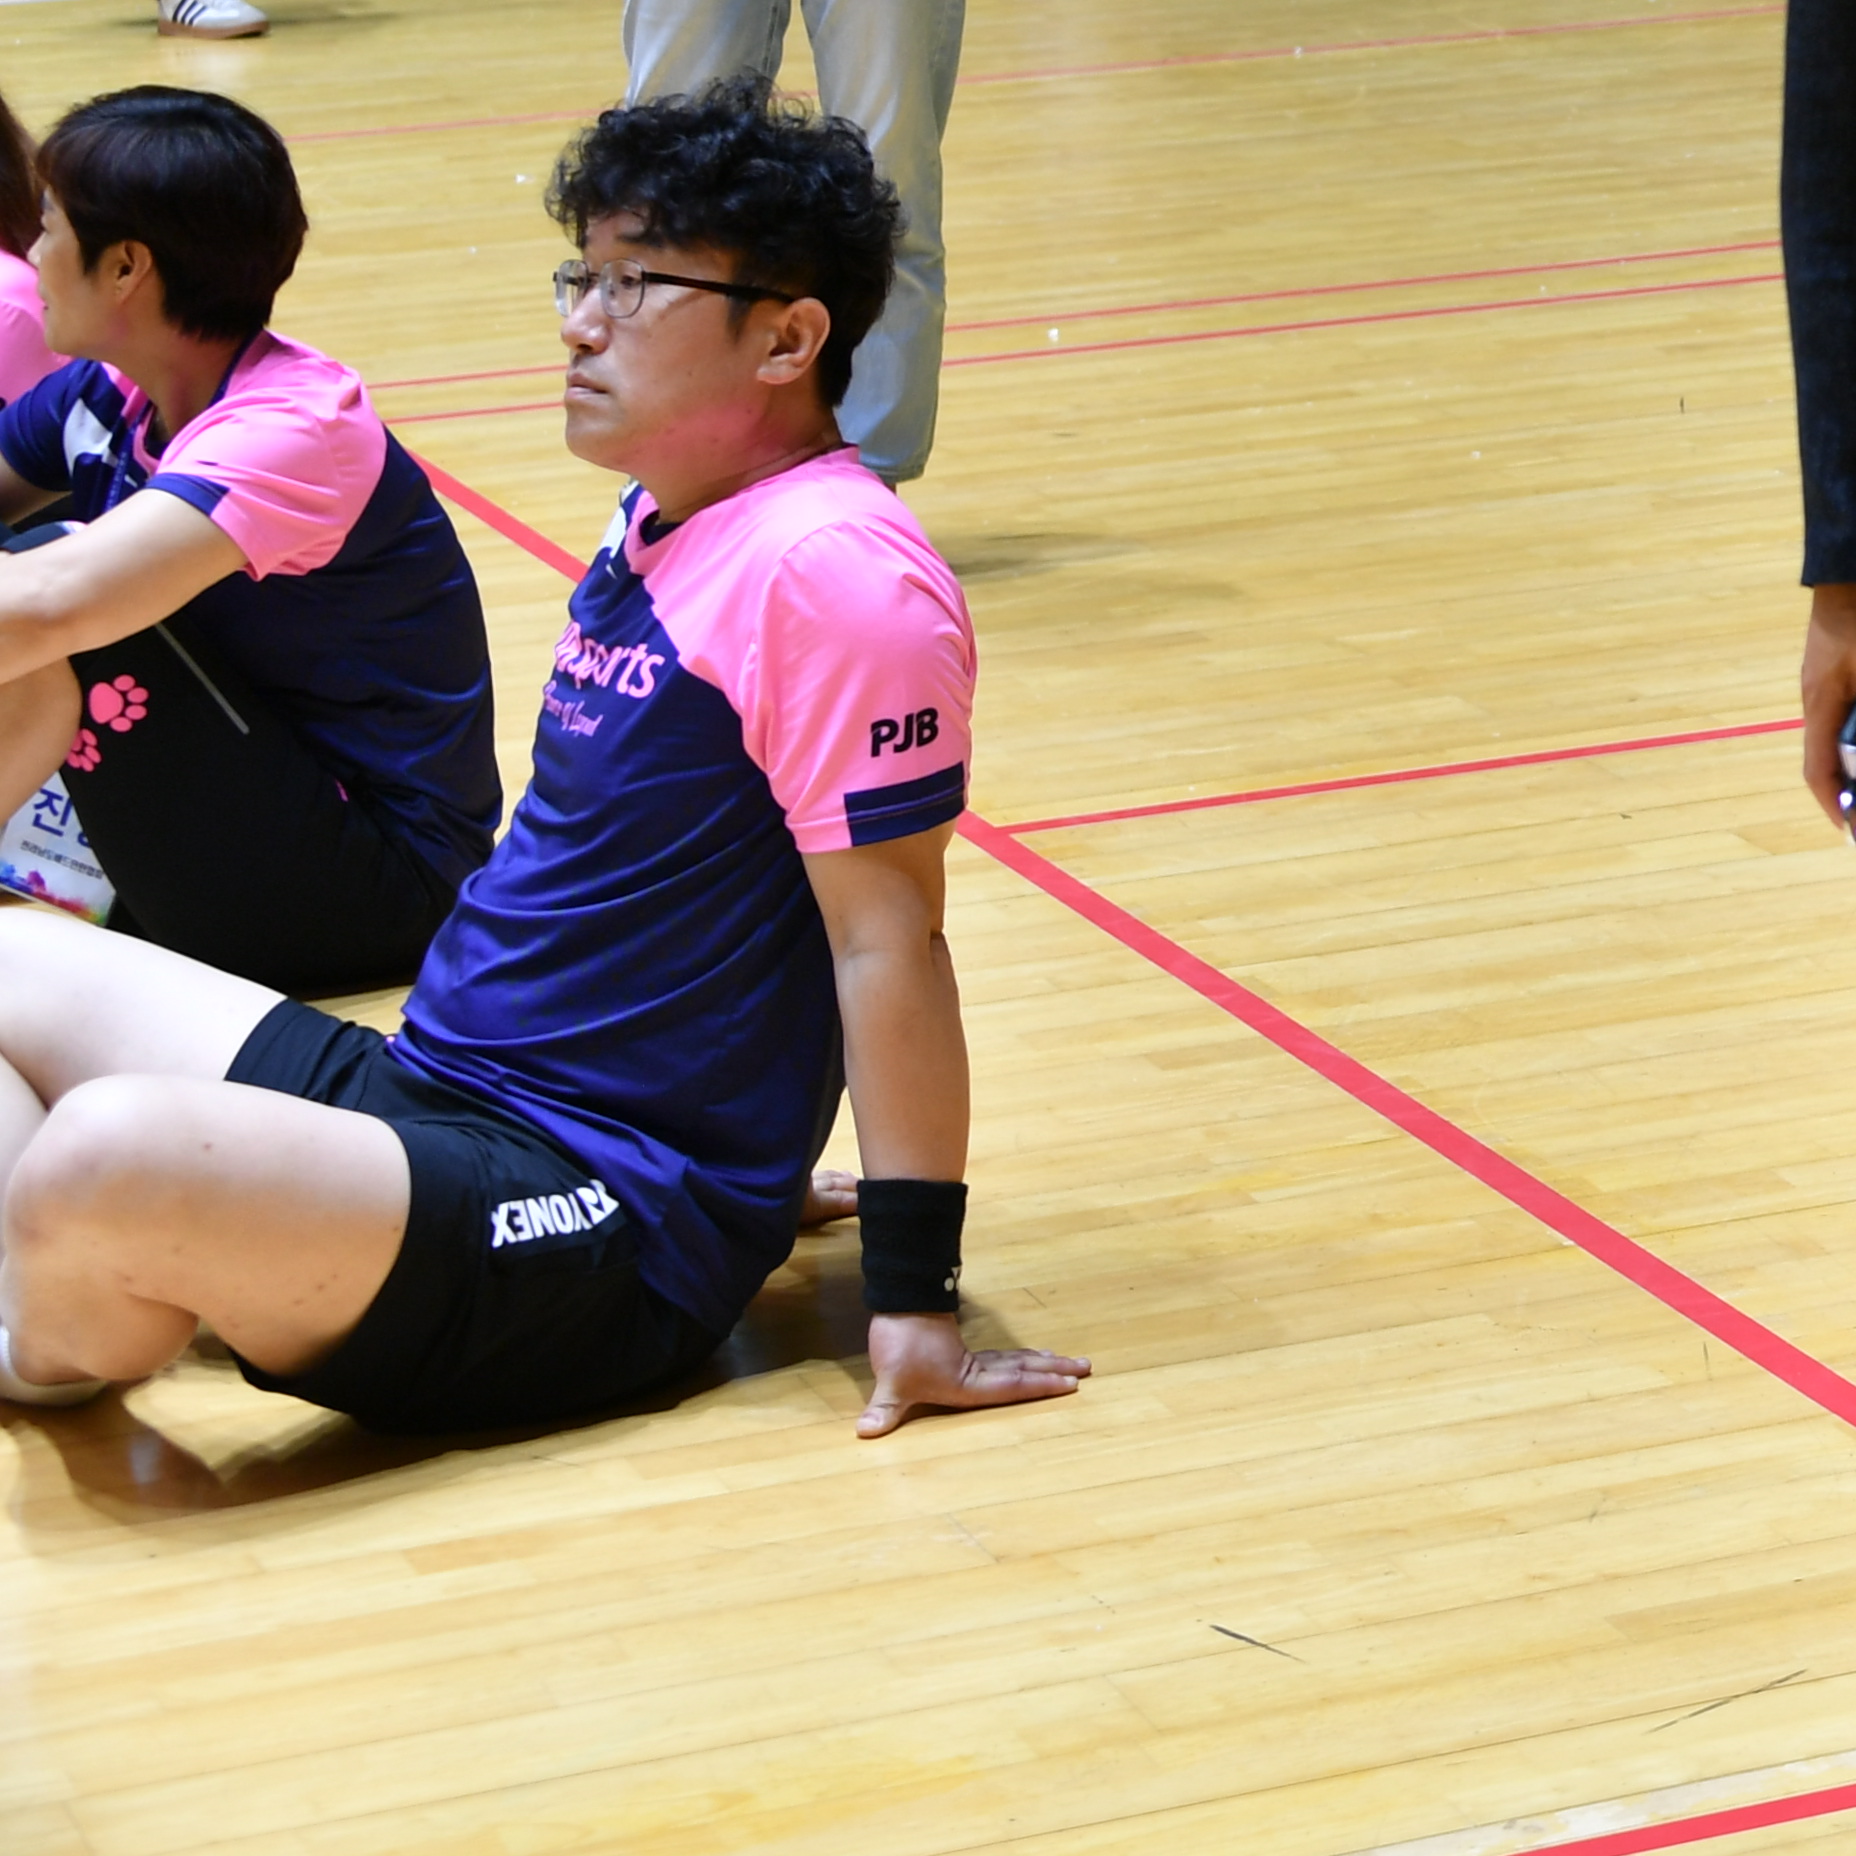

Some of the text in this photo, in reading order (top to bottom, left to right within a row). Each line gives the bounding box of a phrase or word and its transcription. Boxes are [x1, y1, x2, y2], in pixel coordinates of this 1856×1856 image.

[870, 707, 939, 758] PJB
[32, 788, 91, 848] 진
[491, 1192, 593, 1249] YONEX
